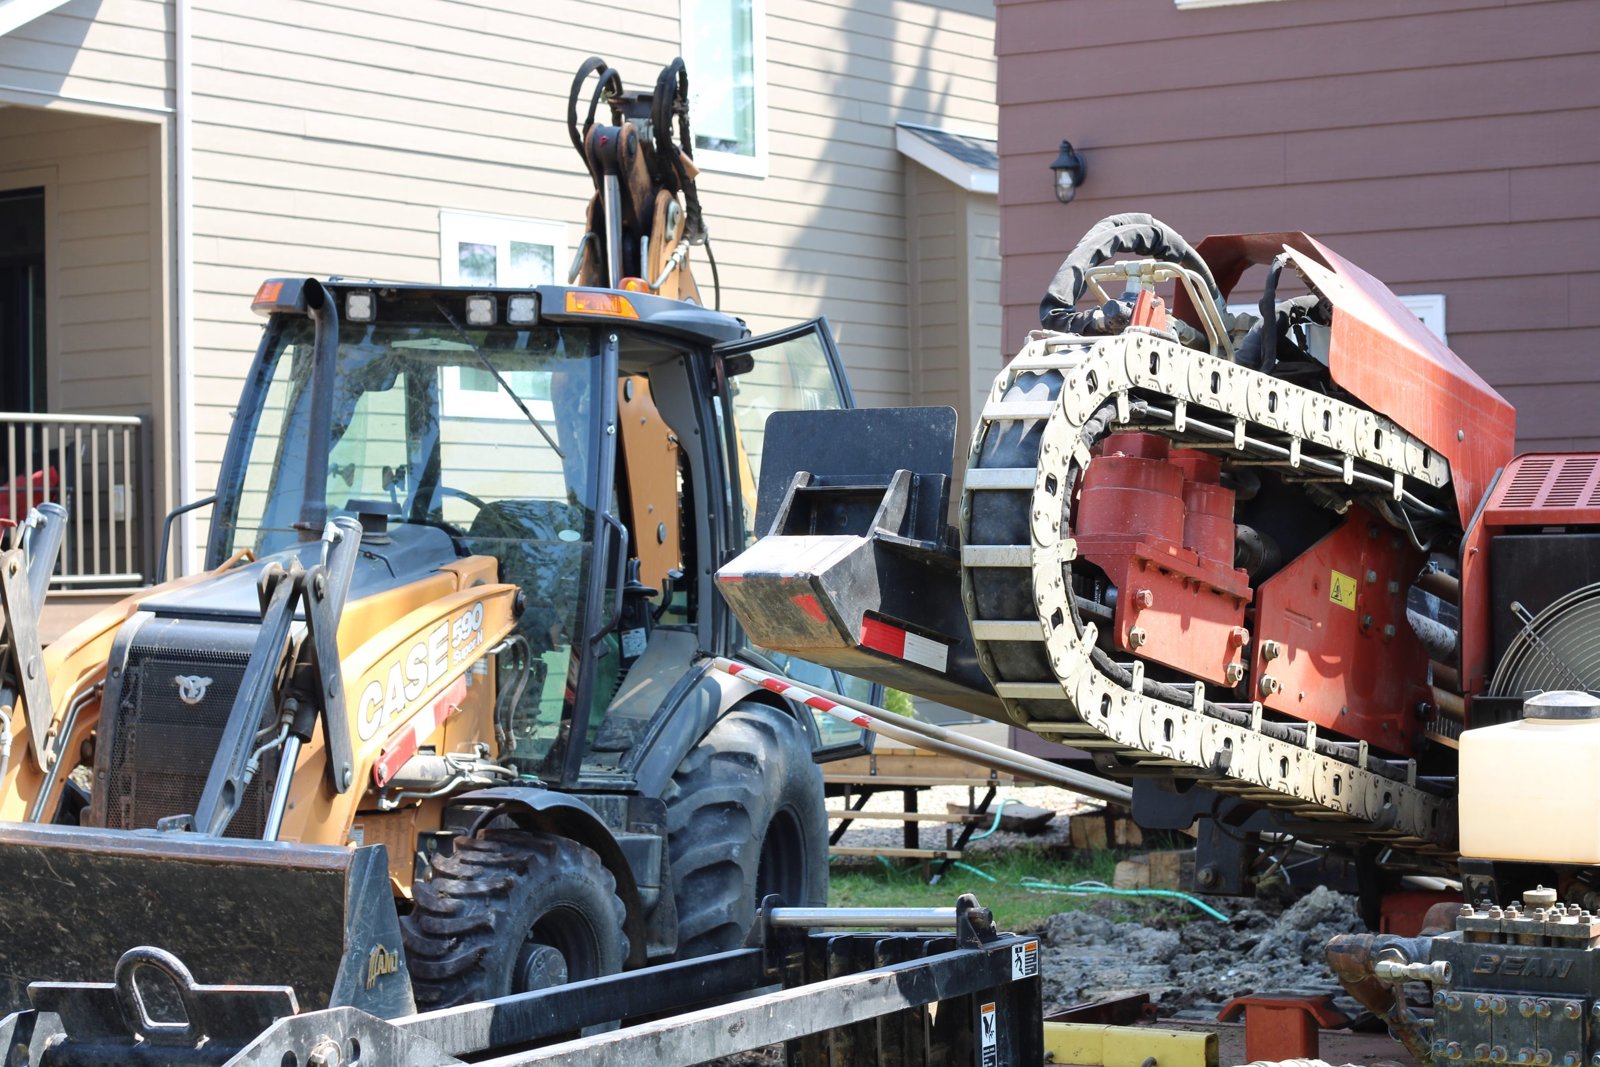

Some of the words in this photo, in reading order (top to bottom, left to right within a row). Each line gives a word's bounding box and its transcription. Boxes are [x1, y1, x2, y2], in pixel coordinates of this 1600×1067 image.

[451, 601, 483, 649] 590
[357, 620, 449, 742] CASE
[1472, 954, 1575, 979] BEAN
